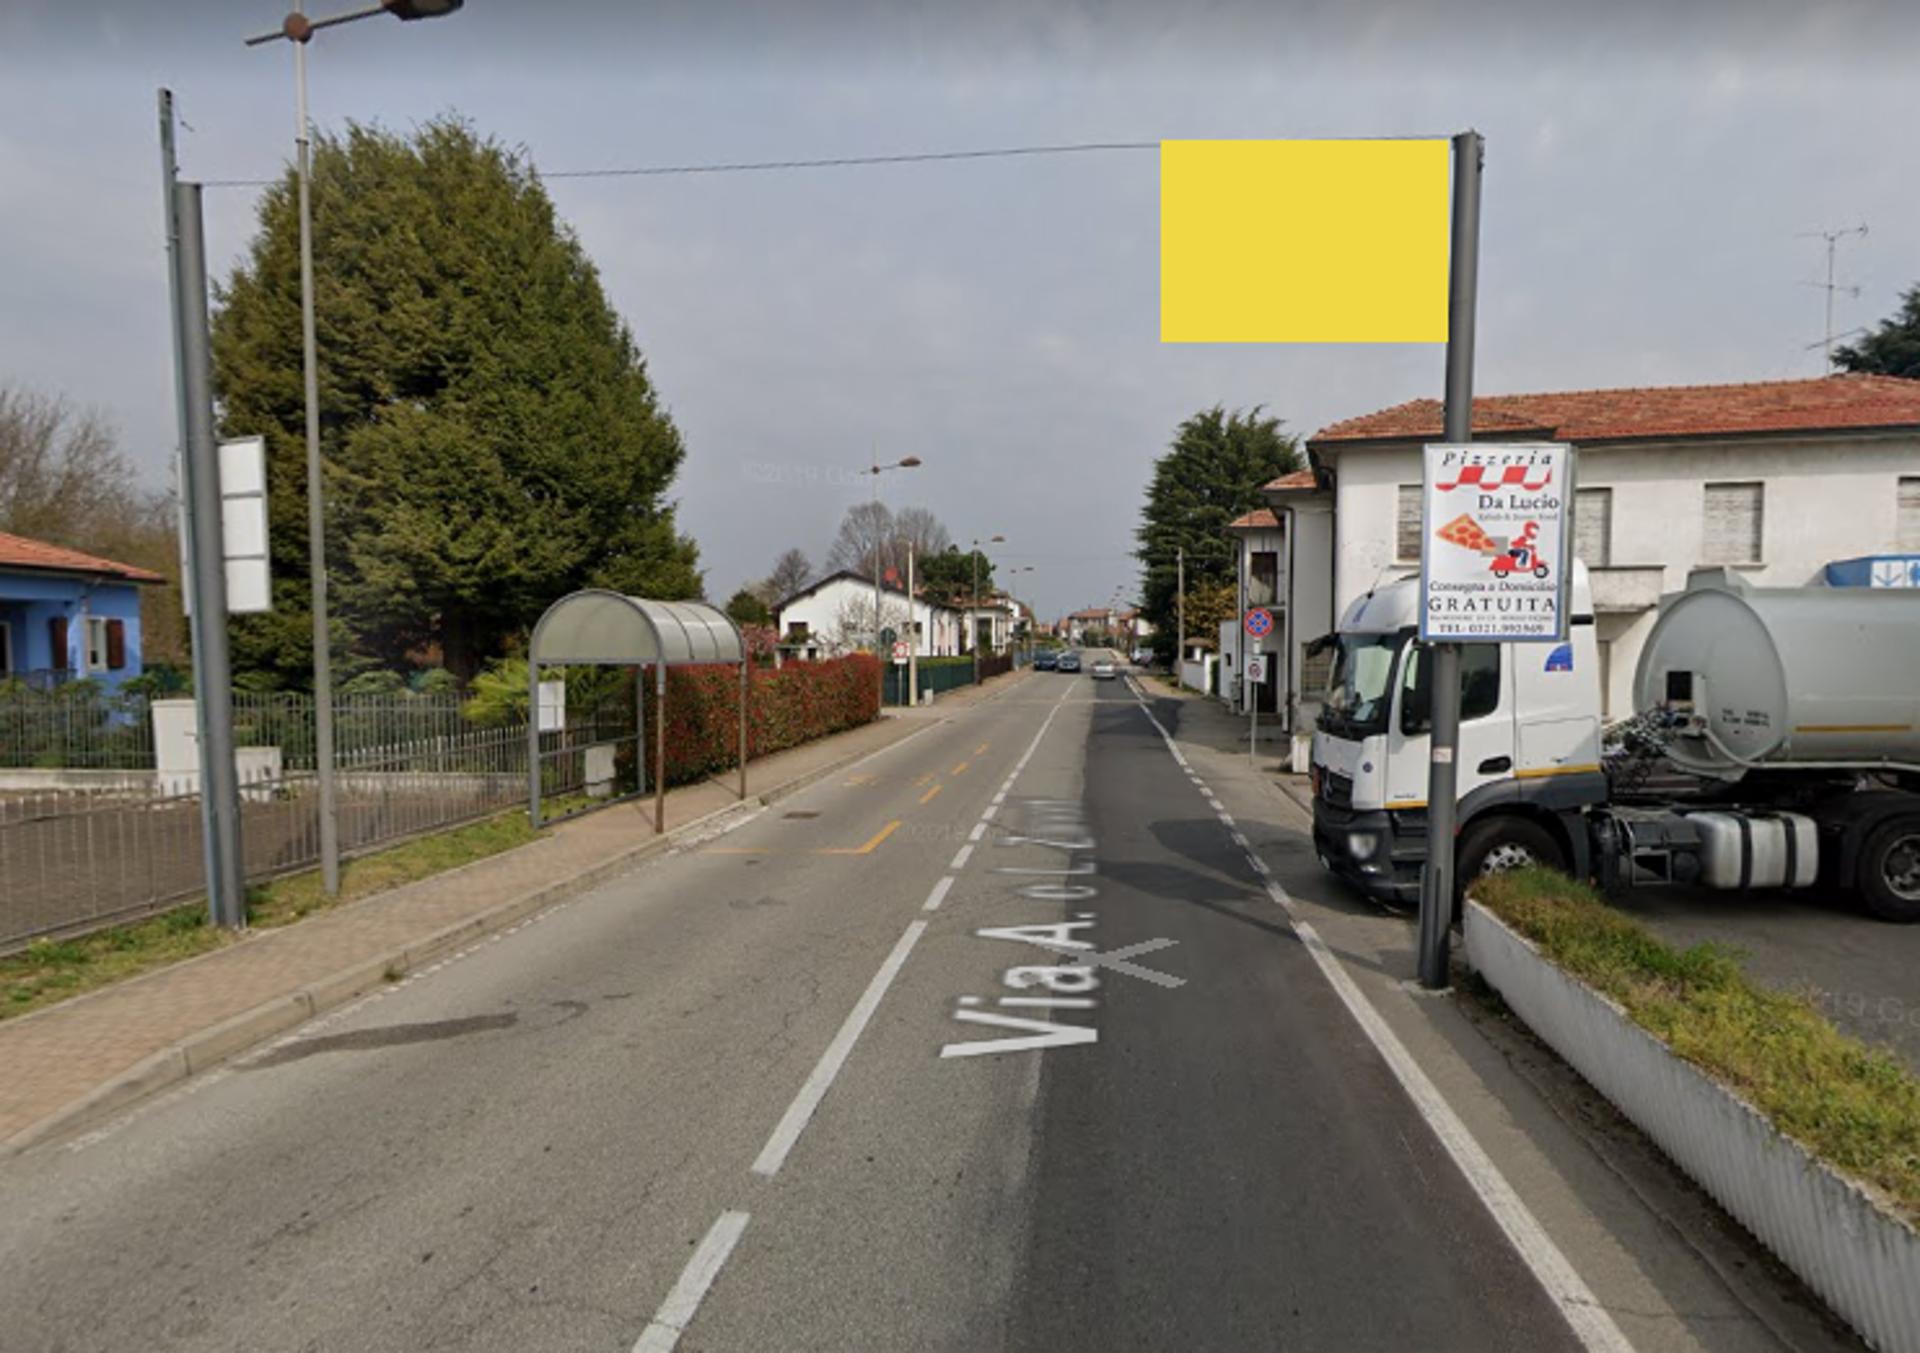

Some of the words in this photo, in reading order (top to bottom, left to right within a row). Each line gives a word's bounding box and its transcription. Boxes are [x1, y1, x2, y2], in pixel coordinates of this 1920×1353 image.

[1442, 450, 1552, 466] Pizzeria
[1479, 494, 1503, 510] Da
[1510, 493, 1560, 510] Lucio
[1429, 580, 1486, 594] Consegna
[1488, 583, 1496, 592] a
[1498, 580, 1557, 592] Domicilio
[1428, 597, 1556, 611] GRATUITA
